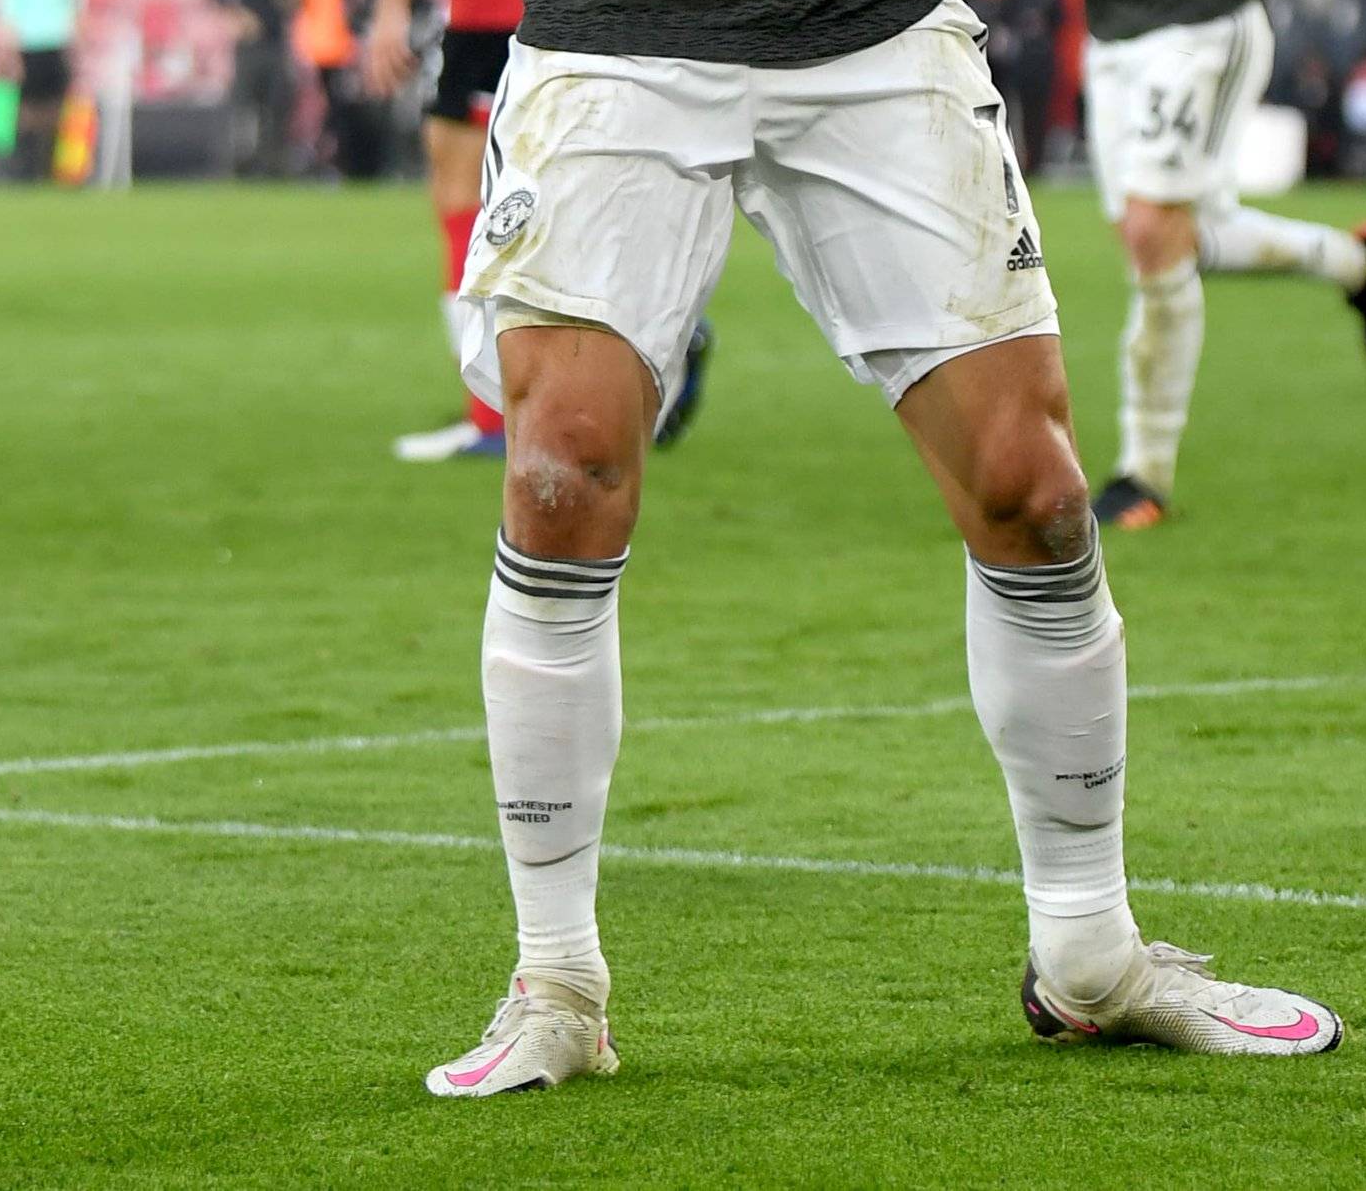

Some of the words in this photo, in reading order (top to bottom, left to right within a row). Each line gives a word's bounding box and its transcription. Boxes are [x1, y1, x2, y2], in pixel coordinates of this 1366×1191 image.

[1140, 86, 1199, 142] 34
[498, 799, 573, 812] NCHESTER
[506, 812, 551, 823] UNITED
